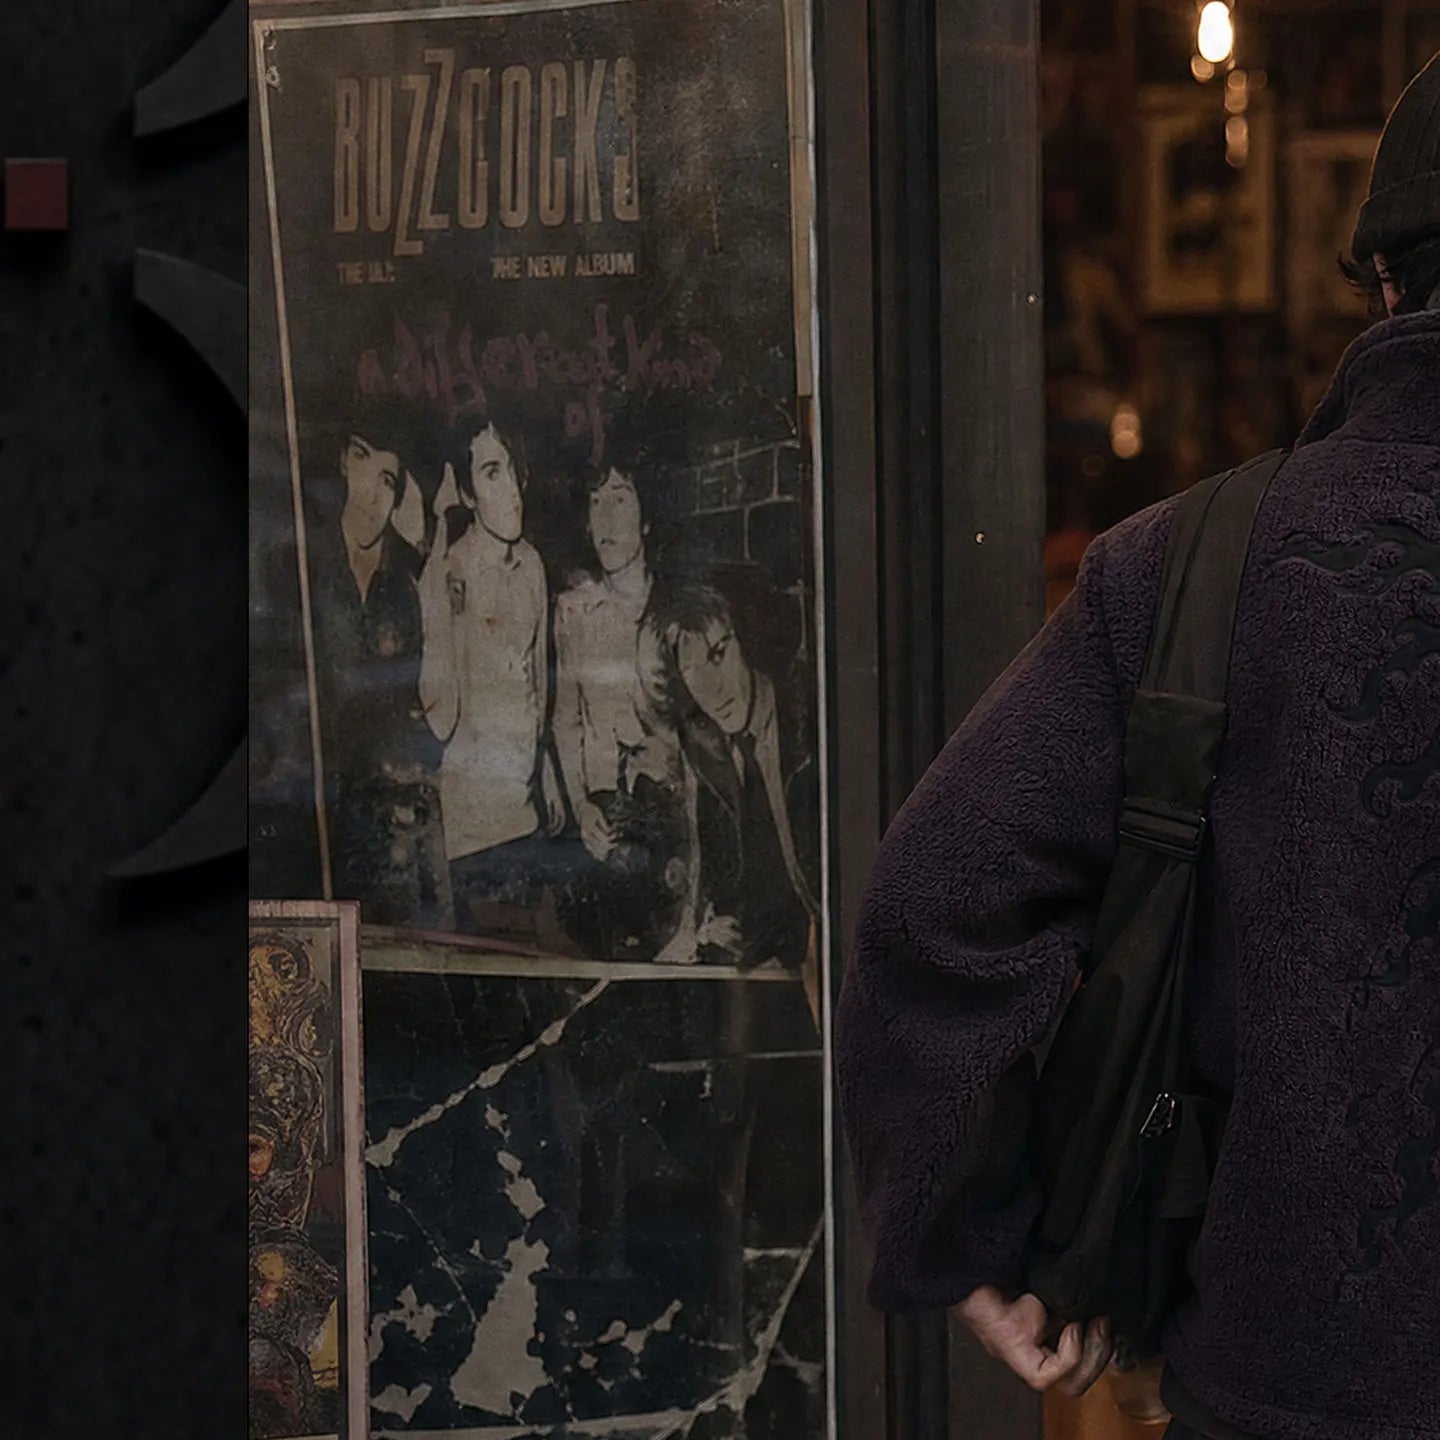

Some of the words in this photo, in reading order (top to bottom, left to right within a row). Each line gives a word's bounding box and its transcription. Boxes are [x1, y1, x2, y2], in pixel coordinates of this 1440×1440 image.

[491, 255, 521, 279] THE
[527, 254, 568, 279] NEW
[575, 252, 636, 277] ALBUM
